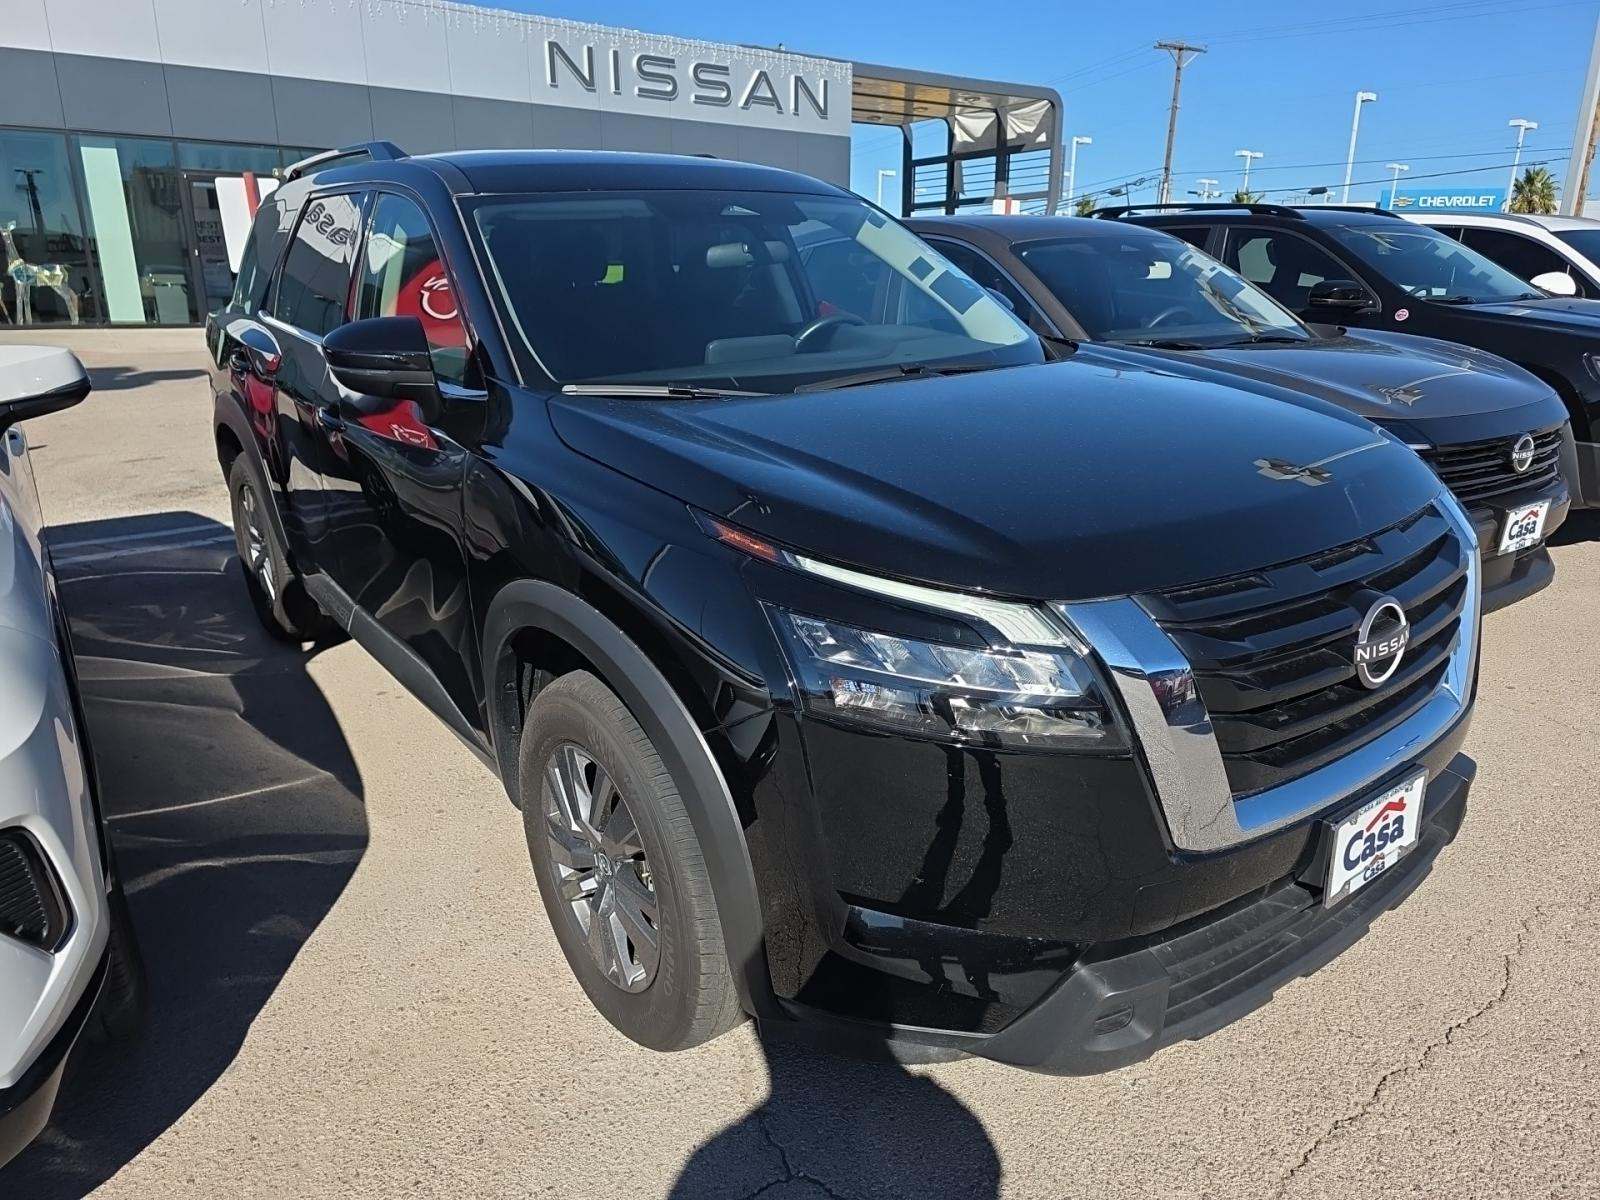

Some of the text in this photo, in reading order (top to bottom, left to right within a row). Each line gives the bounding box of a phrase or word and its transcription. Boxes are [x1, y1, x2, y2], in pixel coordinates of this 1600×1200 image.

[545, 40, 828, 119] NISSAN
[1419, 196, 1496, 207] CHEVROLET
[1509, 519, 1537, 541] Casa
[1343, 815, 1404, 871] Casa
[1363, 861, 1386, 881] Casa
